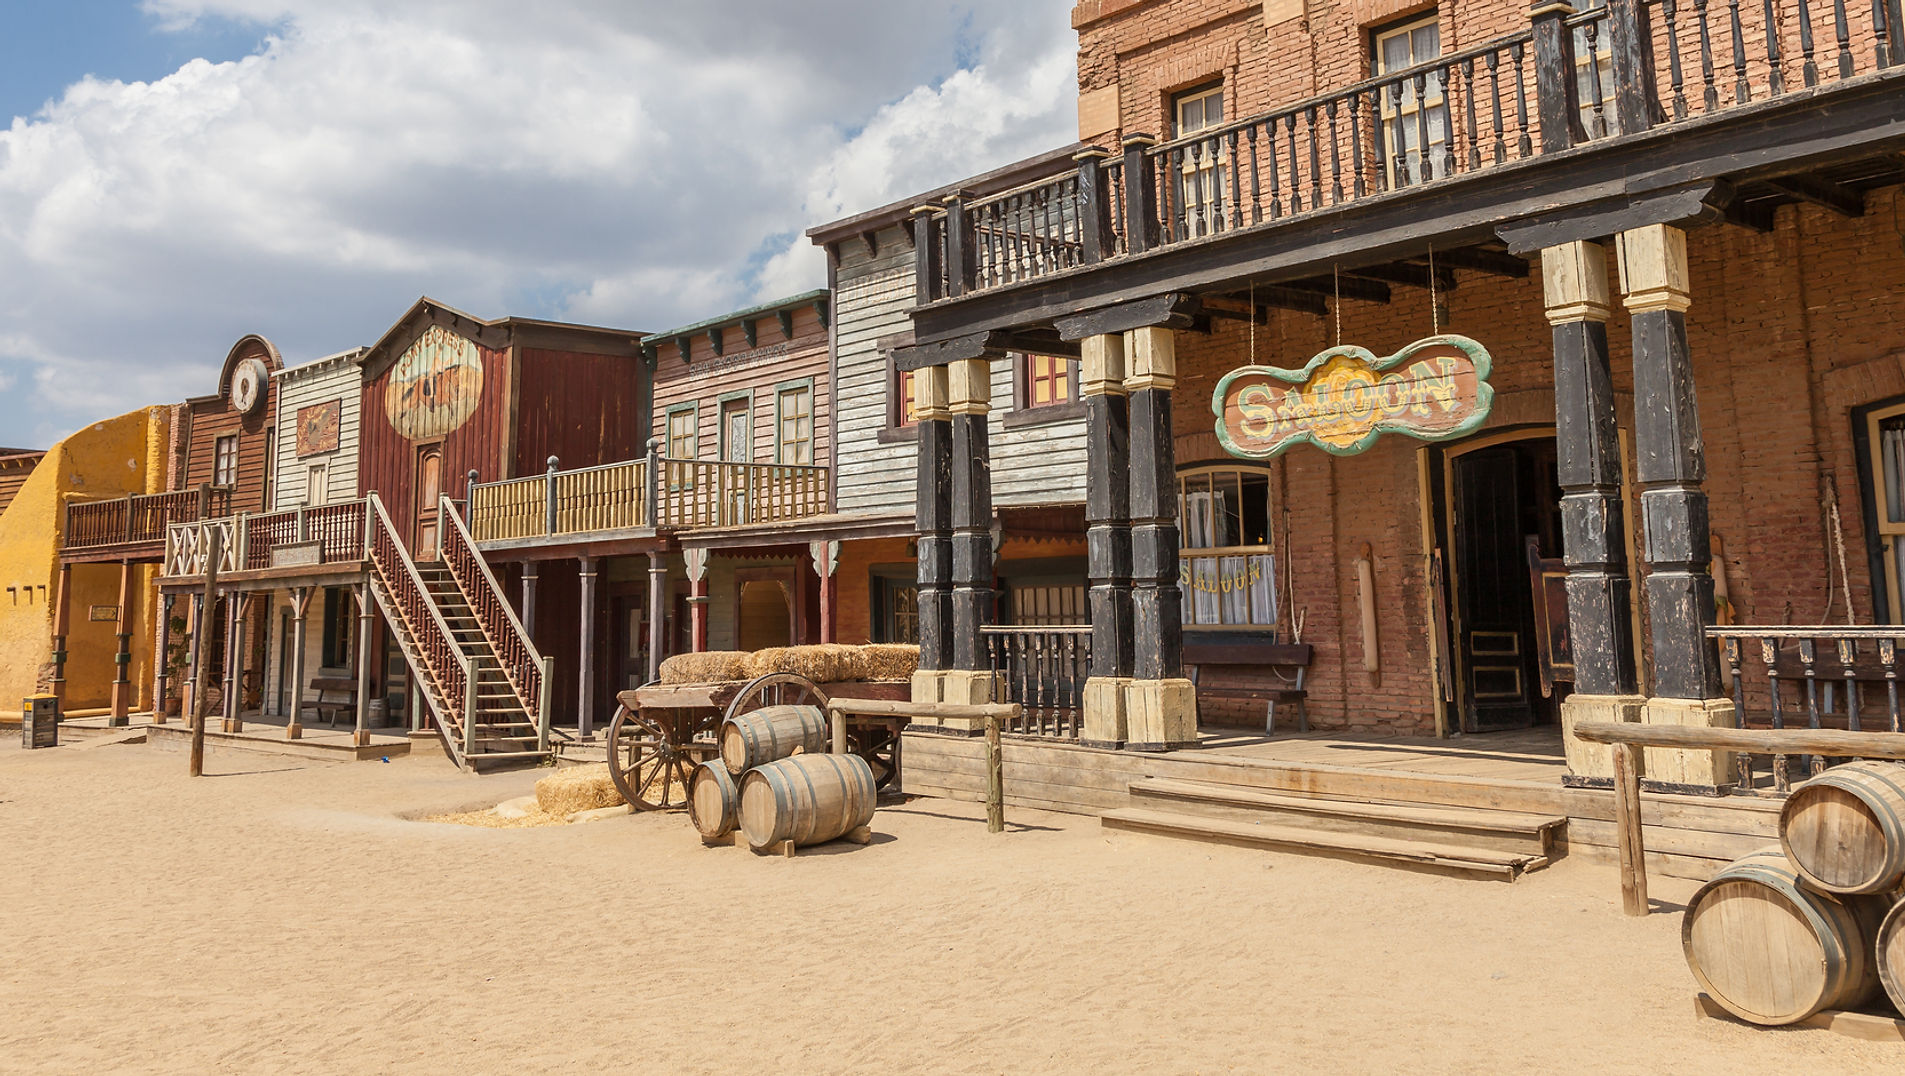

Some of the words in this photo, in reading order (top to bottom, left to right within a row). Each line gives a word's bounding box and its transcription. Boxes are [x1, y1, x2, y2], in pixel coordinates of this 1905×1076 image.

[400, 339, 423, 377] PONY
[424, 329, 465, 357] EXPRESS
[1237, 356, 1458, 439] SALOON
[1180, 560, 1261, 594] SALOON
